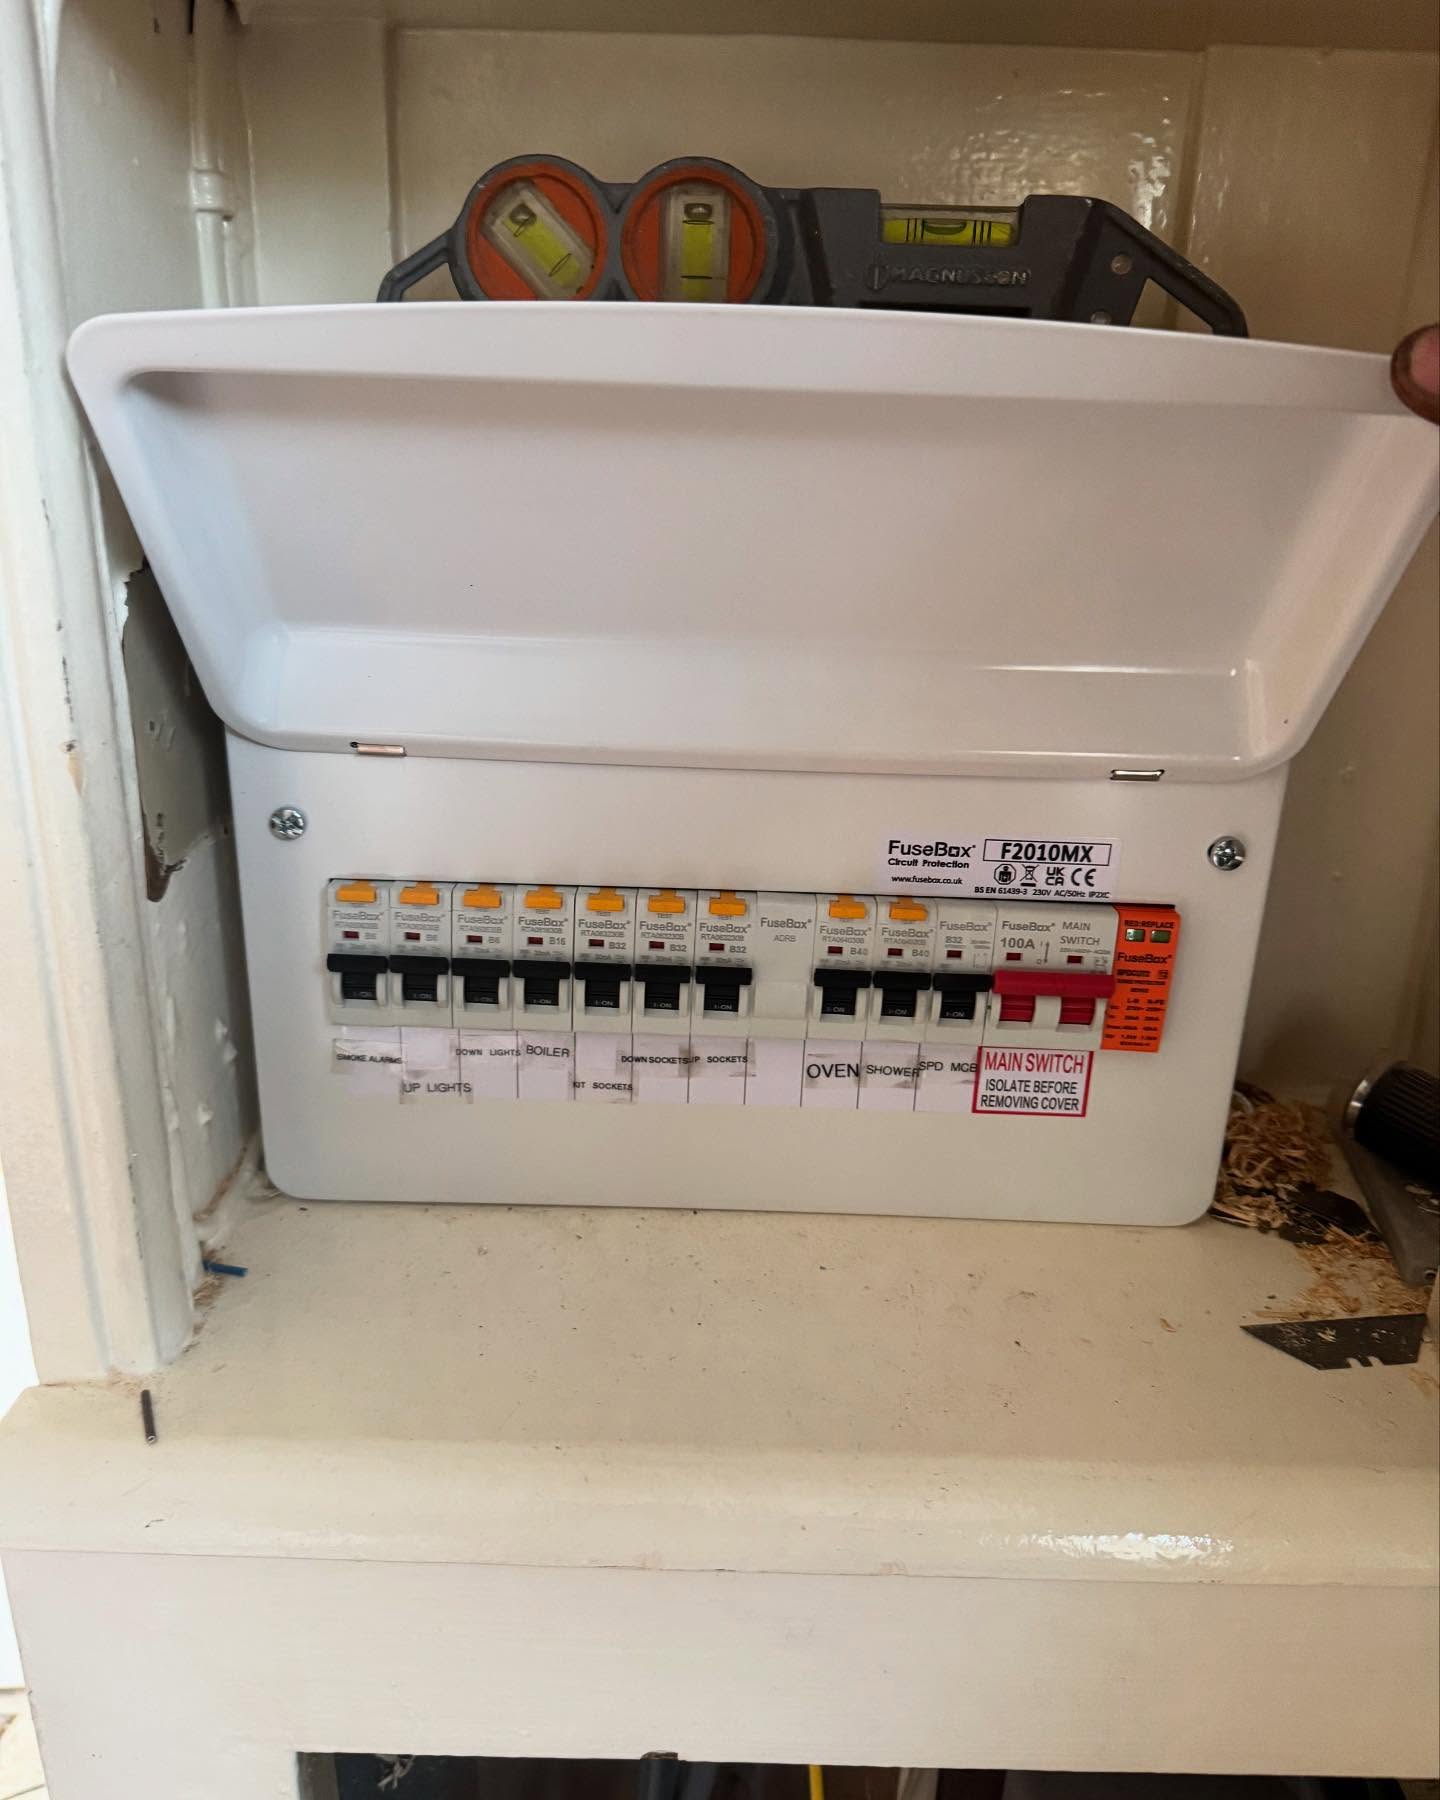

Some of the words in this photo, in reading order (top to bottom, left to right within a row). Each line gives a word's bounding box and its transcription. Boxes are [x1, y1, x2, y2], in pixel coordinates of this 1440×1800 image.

[888, 840, 976, 858] FuseBox
[1001, 841, 1093, 863] F2010MX
[888, 858, 918, 867] Circuit
[922, 859, 969, 869] Protection
[891, 875, 963, 885] www.fusebox.co.uk
[974, 886, 985, 894] BS
[985, 887, 997, 895] EN
[998, 887, 1028, 896] 61439-3
[1032, 888, 1052, 897] 230V
[1054, 889, 1086, 899] AC/50Hz
[518, 916, 569, 928] FuseBox
[578, 919, 630, 930] FuseBox
[639, 921, 692, 933] FuseBox
[699, 922, 752, 934] FuseBox
[760, 917, 812, 930] FuseBox
[940, 920, 992, 932] FuseBox
[1001, 920, 1055, 932] FuseBox
[1062, 921, 1091, 931] MAIN
[820, 925, 872, 937] FuseBox
[881, 927, 934, 938] FuseBox
[608, 941, 627, 950] B32
[1000, 937, 1035, 949] 100A
[1060, 935, 1100, 946] SWITCH
[669, 944, 688, 953] B32
[729, 945, 747, 954] B32
[1117, 952, 1172, 964] FuseBox
[455, 1048, 483, 1057] DOWN
[489, 1049, 521, 1058] LIGHTS
[526, 1044, 570, 1058] BOILER
[336, 1053, 367, 1063] SMOKE
[621, 1055, 648, 1064] DOWN
[648, 1056, 688, 1066] SOCKETS
[706, 1055, 749, 1064] SOCKETS
[984, 1051, 1023, 1072] MAIN
[1025, 1052, 1085, 1074] SWITCH
[806, 1063, 861, 1079] OVEN
[866, 1064, 920, 1078] SHOWER
[919, 1061, 943, 1071] SPD
[403, 1082, 421, 1094] UP
[427, 1082, 472, 1094] LIGHTS
[592, 1081, 634, 1091] SOCKETS
[985, 1078, 1031, 1093] ISOLATE
[1032, 1080, 1078, 1095] BEFORE
[980, 1094, 1039, 1109] REMOVING
[1040, 1096, 1080, 1111] COVER
